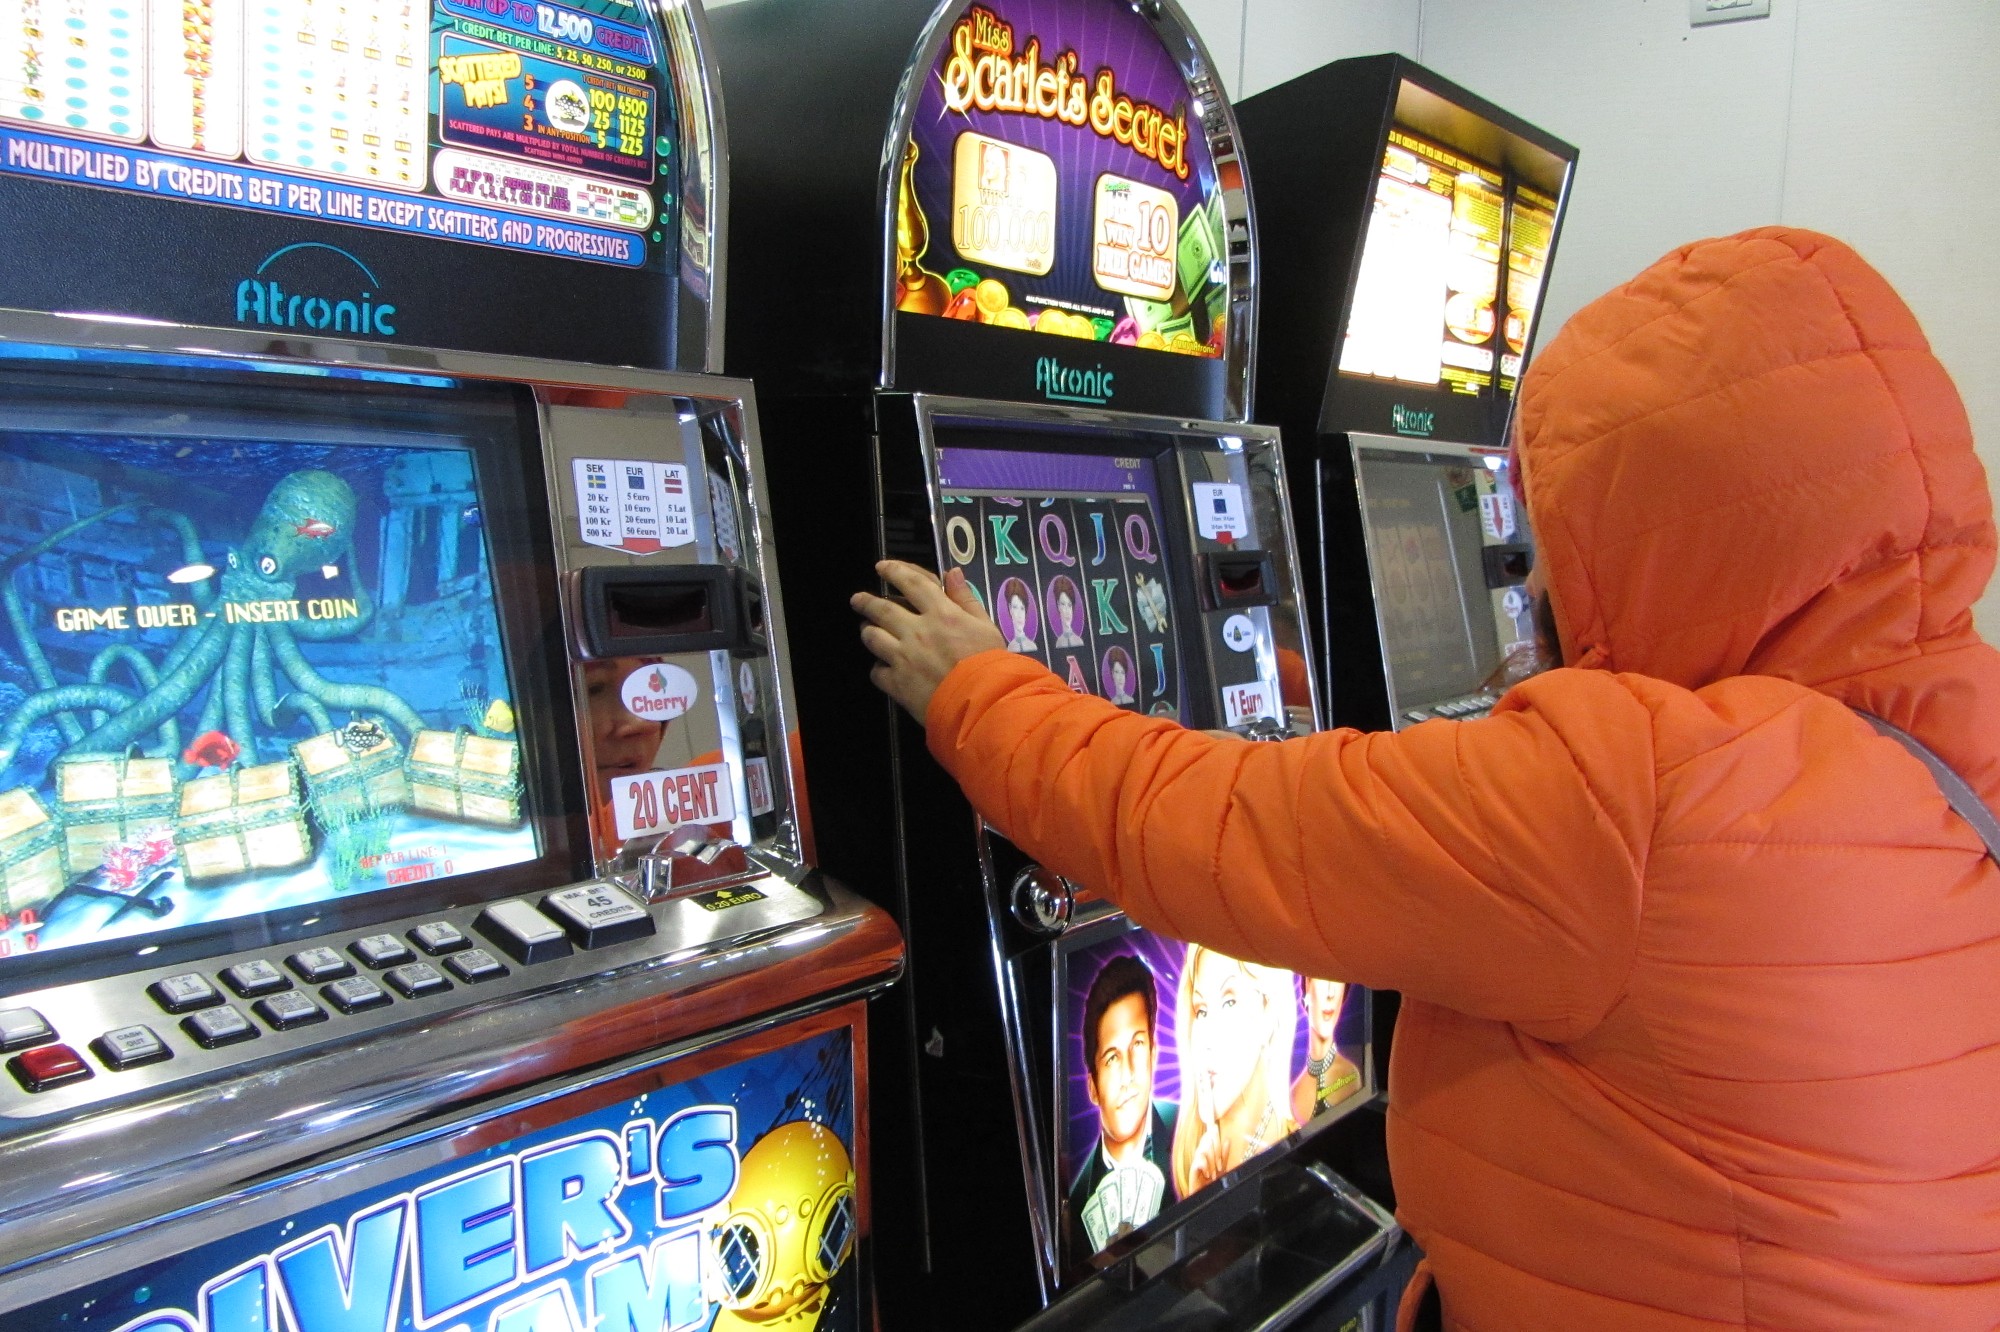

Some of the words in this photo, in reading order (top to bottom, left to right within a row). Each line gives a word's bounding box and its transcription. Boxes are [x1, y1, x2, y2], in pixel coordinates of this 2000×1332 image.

[512, 3, 534, 24] TO
[537, 6, 592, 44] 12,500
[975, 13, 1010, 49] Miss
[454, 19, 459, 31] 1
[462, 21, 494, 40] CREDIT
[496, 30, 512, 45] BET
[515, 35, 532, 50] PER
[533, 39, 555, 57] LINE:
[556, 46, 564, 61] 5,
[566, 50, 580, 65] 25,
[581, 53, 594, 69] 50,
[596, 56, 613, 73] 250,
[616, 64, 624, 75] or
[626, 65, 646, 80] 2500
[524, 75, 535, 90] 5
[523, 94, 534, 111] 4
[590, 88, 615, 112] 100
[618, 95, 647, 119] 4500
[945, 21, 1087, 126] Scarlet's
[1090, 67, 1188, 178] Secret
[523, 114, 534, 131] 3
[594, 110, 610, 130] 25
[619, 114, 645, 137] 1125
[449, 120, 485, 135] SCATTERED
[486, 127, 501, 138] PAYS
[502, 131, 515, 141] ARE
[516, 134, 551, 149] MULTIPLIED
[561, 143, 579, 155] TOTAL
[597, 130, 606, 148] 5
[620, 134, 643, 156] 225
[453, 166, 469, 180] BET
[503, 176, 534, 192] CREDITS
[536, 182, 550, 195] PER
[586, 184, 614, 196] EXTRA
[9, 138, 129, 183] MULTIPLIED
[136, 160, 168, 191] BY
[167, 164, 243, 200] CREDITS
[249, 178, 283, 208] BET
[288, 184, 322, 216] PER
[327, 190, 362, 219] LINE
[368, 197, 424, 229] EXCEPT
[428, 210, 498, 242] SCATTERS
[502, 220, 532, 245] AND
[537, 225, 629, 260] PROGRESSIVES
[450, 178, 475, 194] PLAY
[543, 195, 571, 212] LINES
[1136, 201, 1171, 255] 10
[1129, 251, 1172, 289] GAMES
[236, 279, 397, 336] Atronic
[1036, 357, 1114, 400] Atronic
[1392, 404, 1434, 433] Atronic
[586, 464, 604, 474] SEK
[626, 467, 643, 476] EUR
[1115, 458, 1140, 469] CREDIT
[664, 470, 679, 478] LAT
[587, 494, 597, 502] 20
[598, 494, 609, 502] Kr
[627, 493, 632, 501] 5
[588, 506, 598, 514] 50
[599, 506, 610, 514] Kr
[624, 504, 633, 512] 10
[674, 505, 686, 513] Lat
[585, 517, 599, 525] 100
[600, 518, 611, 526] Kr
[625, 516, 634, 524] 20
[665, 516, 674, 524] 10
[675, 516, 687, 524] Lat
[586, 529, 601, 537] 500
[601, 529, 613, 538] Kr
[626, 527, 635, 535] 50
[666, 527, 674, 535] 20
[675, 527, 688, 535] Lat
[988, 515, 1028, 565] K
[1039, 514, 1076, 567] Q
[1090, 513, 1106, 566] J
[1124, 514, 1157, 564] Q
[56, 607, 129, 632] GAME
[137, 604, 197, 628] OVER
[226, 600, 300, 624] INSERT
[307, 599, 358, 620] COIN
[1092, 579, 1128, 635] K
[1150, 643, 1166, 696] J
[632, 696, 688, 713] Cherry
[1230, 691, 1237, 717] 1
[1238, 690, 1263, 715] Euro
[629, 780, 658, 830] 20
[662, 771, 718, 825] CENT
[383, 852, 405, 865] PER
[408, 847, 438, 861] LINE:
[387, 863, 441, 885] CREDIT:
[444, 860, 454, 875] 0
[588, 896, 612, 907] 45
[590, 905, 634, 918] CREDITS
[705, 899, 728, 912] 0.20
[730, 892, 762, 907] EURO
[116, 1031, 143, 1040] CASH
[112, 1105, 740, 1332] IVER'S
